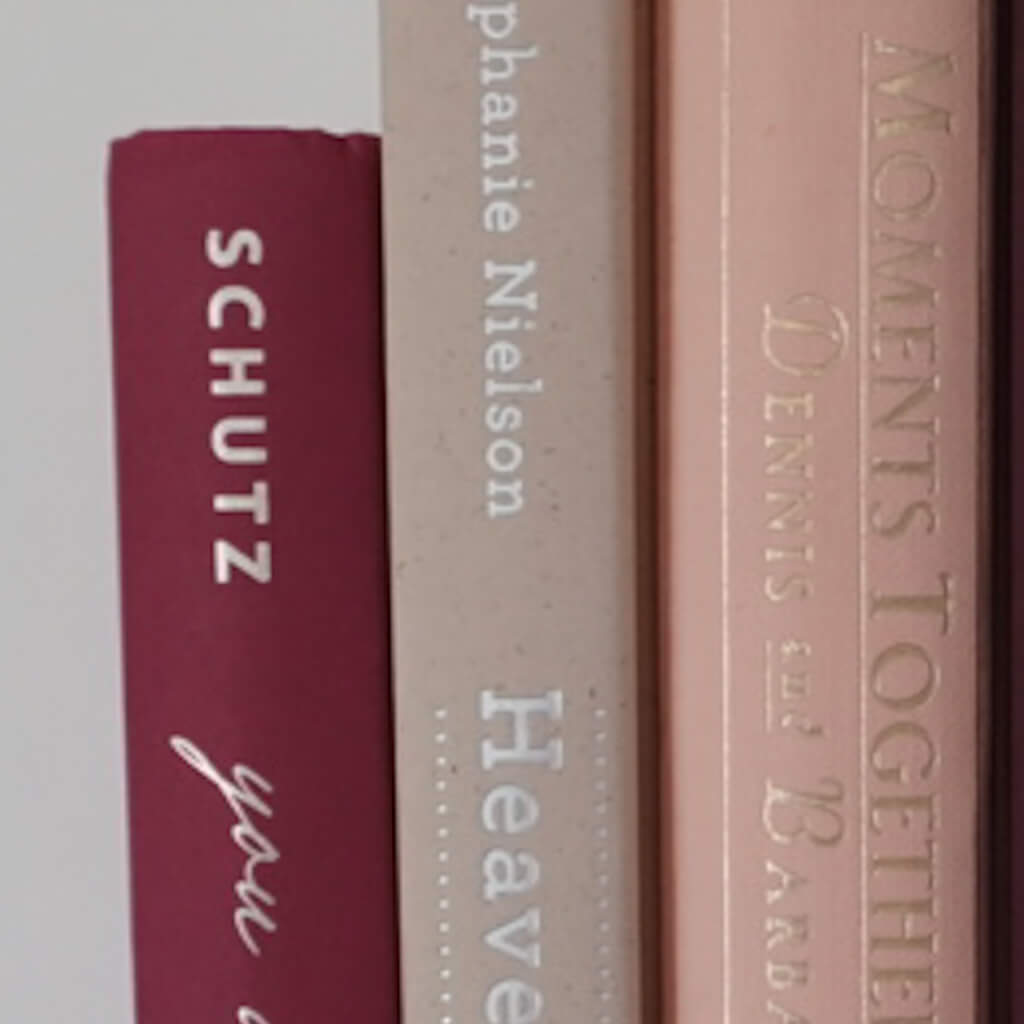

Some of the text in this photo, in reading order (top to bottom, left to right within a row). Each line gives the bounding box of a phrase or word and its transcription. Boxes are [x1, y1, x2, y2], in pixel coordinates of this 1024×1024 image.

[205, 228, 272, 585] SCHUTZ
[484, 260, 543, 519] Nielson
[870, 40, 956, 540] MOMENTS
[763, 293, 849, 602] DENNIS
[169, 735, 280, 957] you
